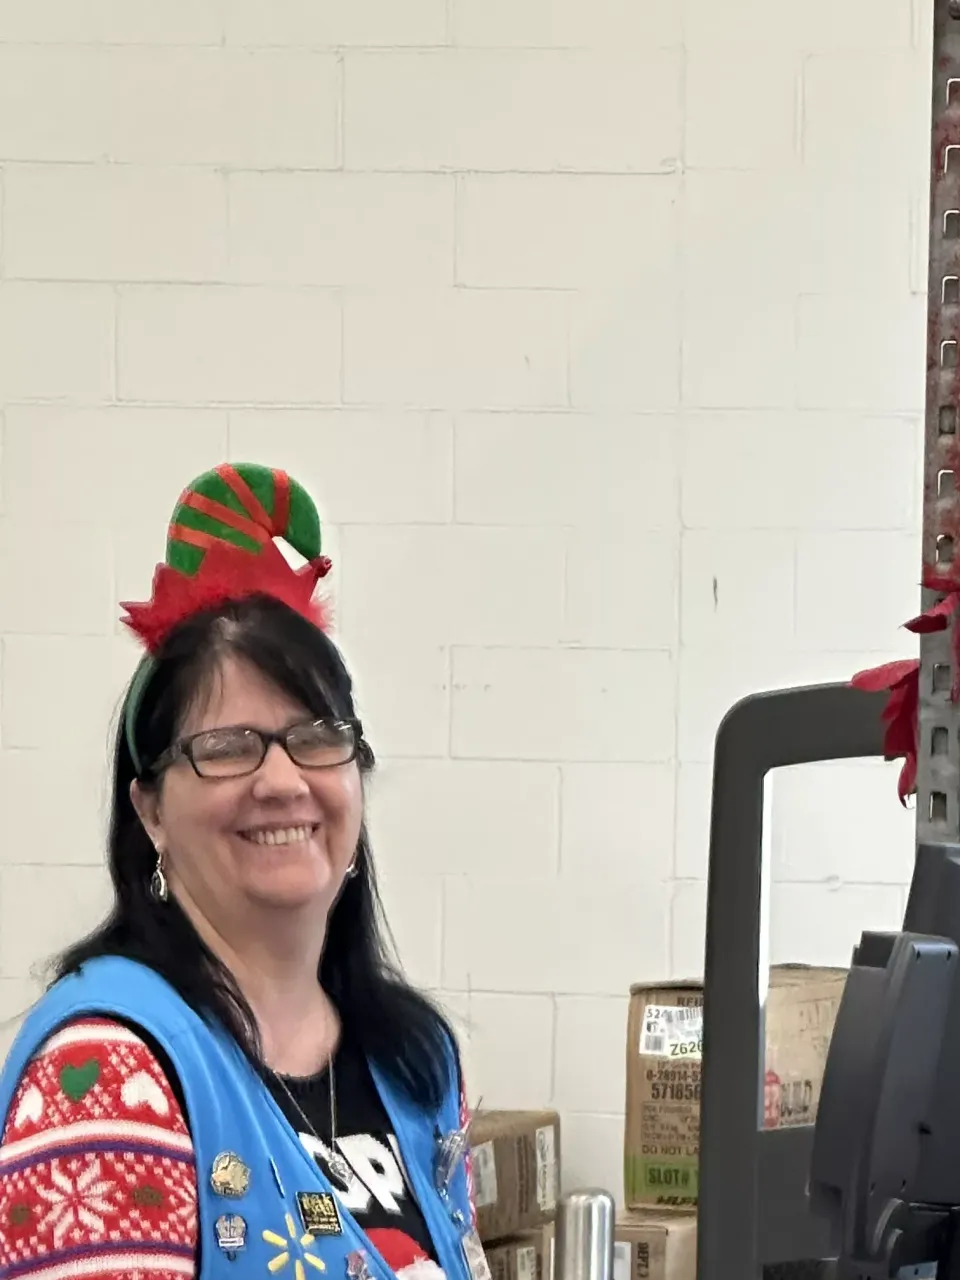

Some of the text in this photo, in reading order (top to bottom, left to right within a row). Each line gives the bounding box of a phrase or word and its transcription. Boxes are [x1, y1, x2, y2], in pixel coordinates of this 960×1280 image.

[297, 1131, 412, 1216] OP
[641, 1144, 658, 1155] DO
[660, 1145, 682, 1156] NOT
